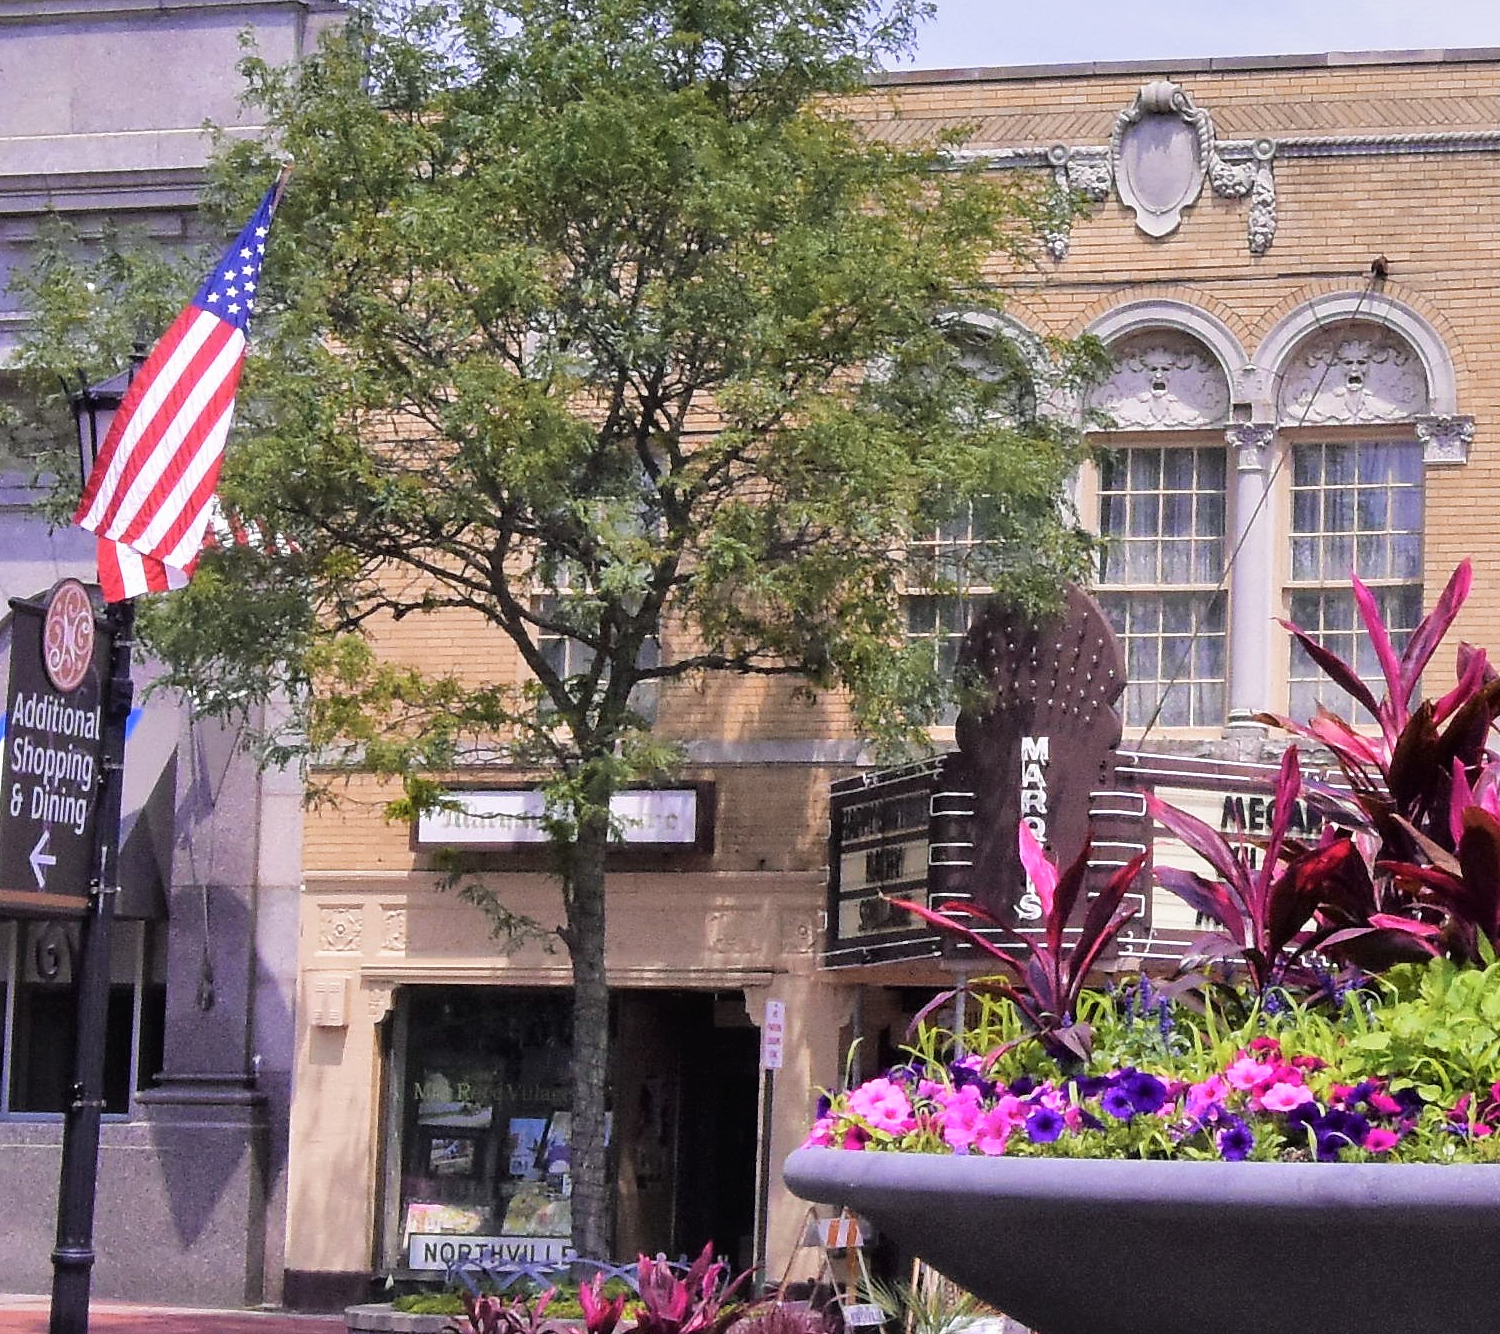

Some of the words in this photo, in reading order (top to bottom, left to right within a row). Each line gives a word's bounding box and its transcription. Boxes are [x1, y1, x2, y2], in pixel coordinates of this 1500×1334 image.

[12, 692, 100, 740] Additional
[11, 737, 93, 791] Shopping
[10, 783, 23, 817] &
[31, 786, 87, 835] Dining
[1014, 736, 1049, 921] MARQIS
